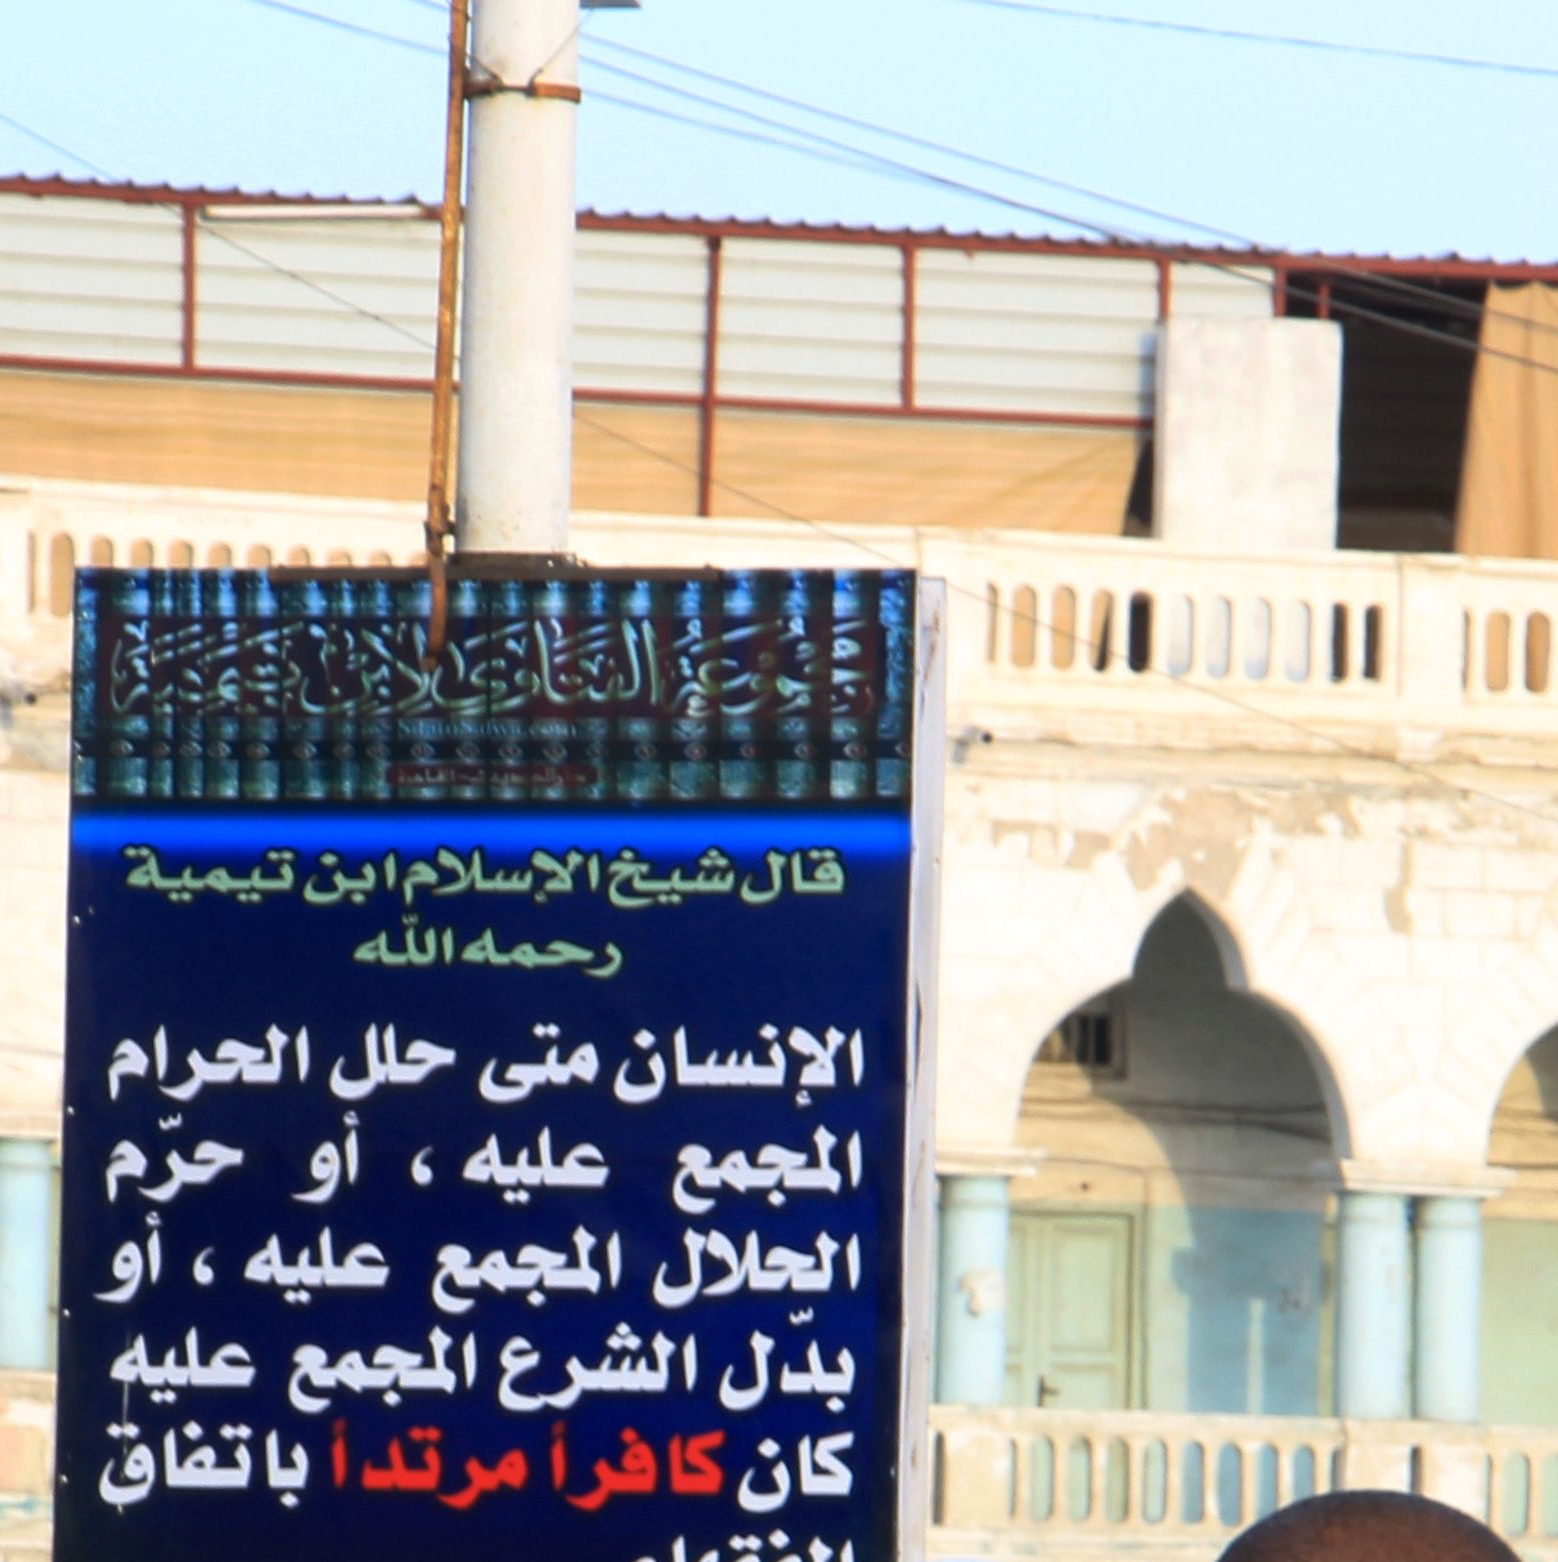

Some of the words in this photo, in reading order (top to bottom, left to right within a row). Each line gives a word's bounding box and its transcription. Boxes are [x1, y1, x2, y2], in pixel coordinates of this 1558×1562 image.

[125, 847, 294, 901] تيمية
[304, 853, 396, 903] ابن
[403, 849, 600, 904] الإسلام
[608, 849, 735, 907] شيخ
[740, 849, 844, 904] قال
[354, 917, 454, 964] الله
[462, 929, 622, 977] رحمه
[108, 1024, 310, 1101] الحرام
[329, 1023, 456, 1100] حلل
[478, 1023, 600, 1103] متى
[613, 1023, 864, 1106] الإنسان
[293, 1111, 359, 1203] أو
[462, 1126, 610, 1204] عليه
[672, 1124, 862, 1215] المجمع
[95, 1211, 162, 1303] أو
[244, 1226, 390, 1304] عليه
[432, 1225, 622, 1314] المجمع
[652, 1227, 861, 1311] الحلال
[109, 1327, 256, 1404] عليه
[288, 1326, 477, 1414] المجمع
[498, 1322, 697, 1412] الشرع
[98, 1420, 309, 1513] باتفاق
[737, 1431, 854, 1513] كان
